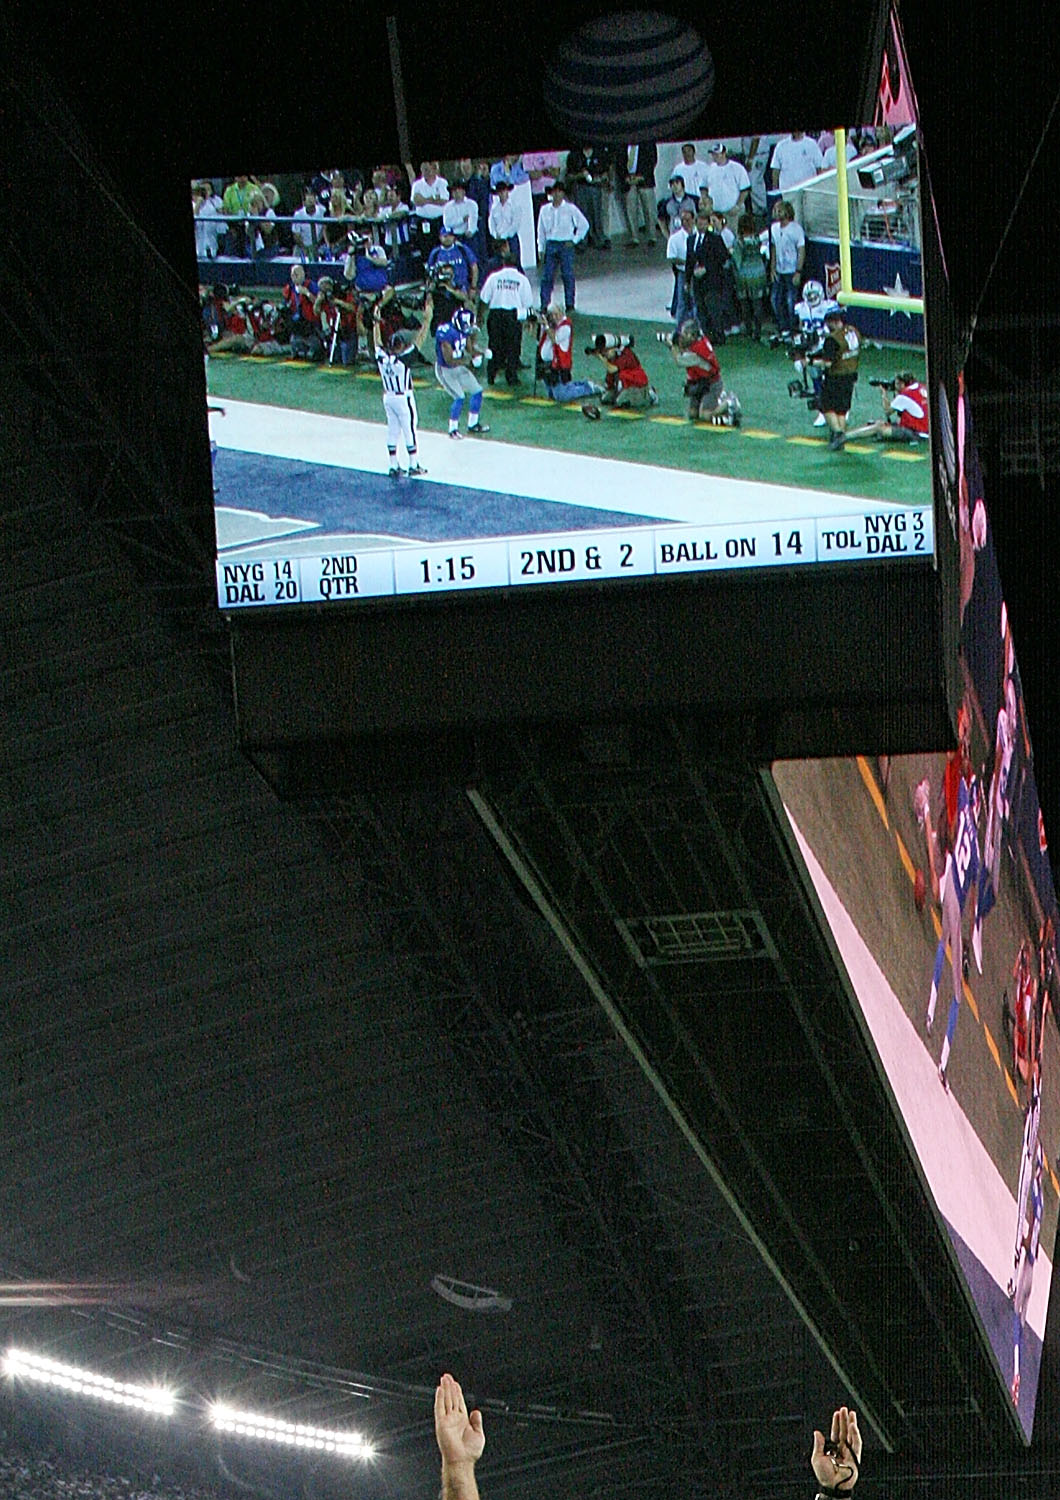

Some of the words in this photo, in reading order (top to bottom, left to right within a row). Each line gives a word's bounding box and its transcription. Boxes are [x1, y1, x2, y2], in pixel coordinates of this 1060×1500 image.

[865, 513, 906, 534] NYG
[913, 512, 924, 530] 3
[661, 541, 718, 563] BALL
[725, 537, 757, 558] ON
[772, 531, 803, 556] 14
[822, 530, 861, 550] TOL
[866, 534, 907, 554] DAL
[914, 533, 925, 551] 2
[322, 555, 358, 577] 2ND
[420, 556, 475, 584] 1:15
[521, 548, 576, 575] 2ND
[585, 546, 601, 569] &
[620, 544, 634, 567] 2
[223, 563, 264, 584] NYG
[274, 561, 292, 580] 14
[225, 582, 265, 604] DAL
[275, 581, 297, 599] 20
[319, 576, 359, 600] QTR
